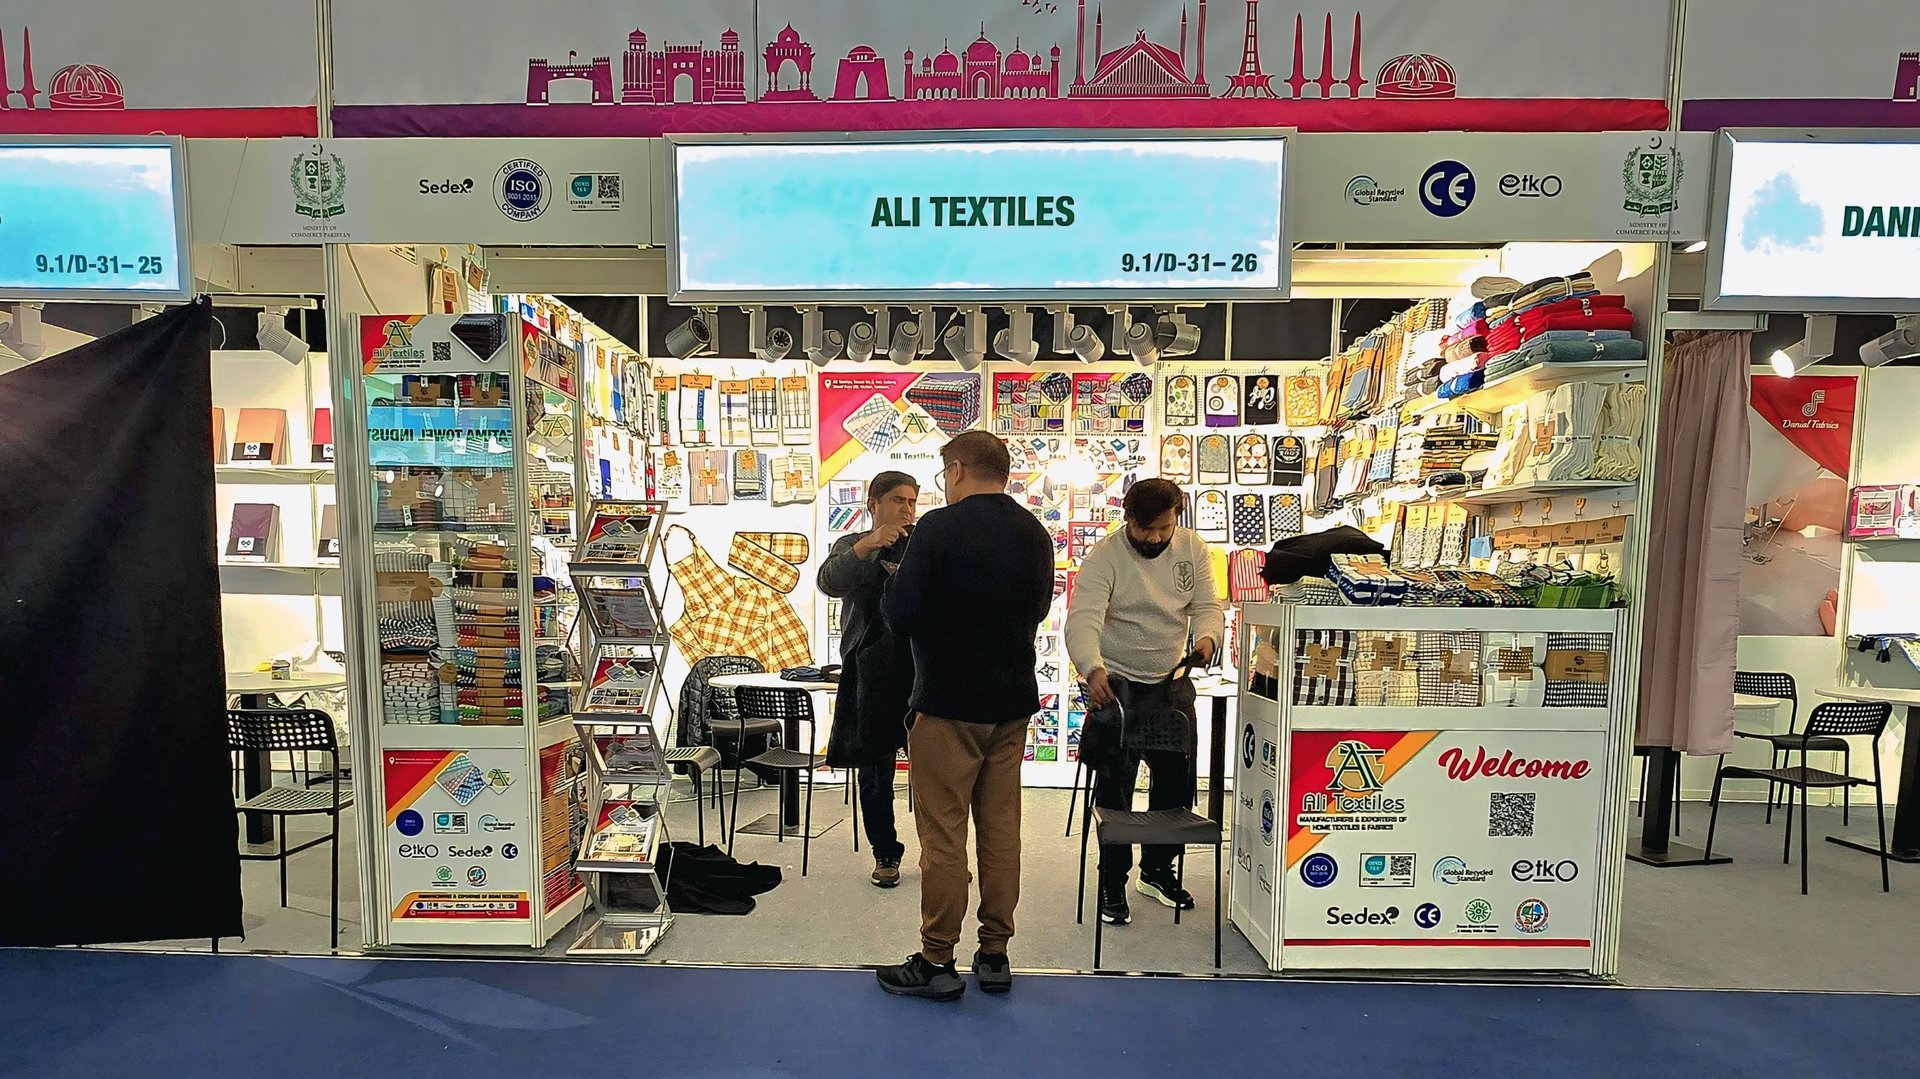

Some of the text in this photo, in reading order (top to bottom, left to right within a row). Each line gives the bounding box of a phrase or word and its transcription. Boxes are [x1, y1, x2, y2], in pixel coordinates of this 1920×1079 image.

[502, 160, 544, 178] CERTIFIED
[419, 178, 474, 194] Sedex
[511, 179, 537, 192] ISO
[1354, 188, 1405, 198] Global Recycled
[1424, 171, 1469, 207] CE
[1368, 195, 1398, 203] Standard
[501, 203, 542, 219] COMPANY
[871, 196, 1075, 228] ALI TEXTILES
[138, 256, 163, 275] 25
[1231, 253, 1258, 273] 26
[389, 348, 424, 358] Textiles
[1438, 745, 1592, 781] Welcome
[1303, 793, 1406, 811] Ali Textiles
[448, 845, 494, 858] Sedex
[1311, 864, 1329, 872] ISO
[1465, 869, 1494, 877] Recycled
[1326, 906, 1400, 925] Sedex
[1416, 907, 1438, 924] CE
